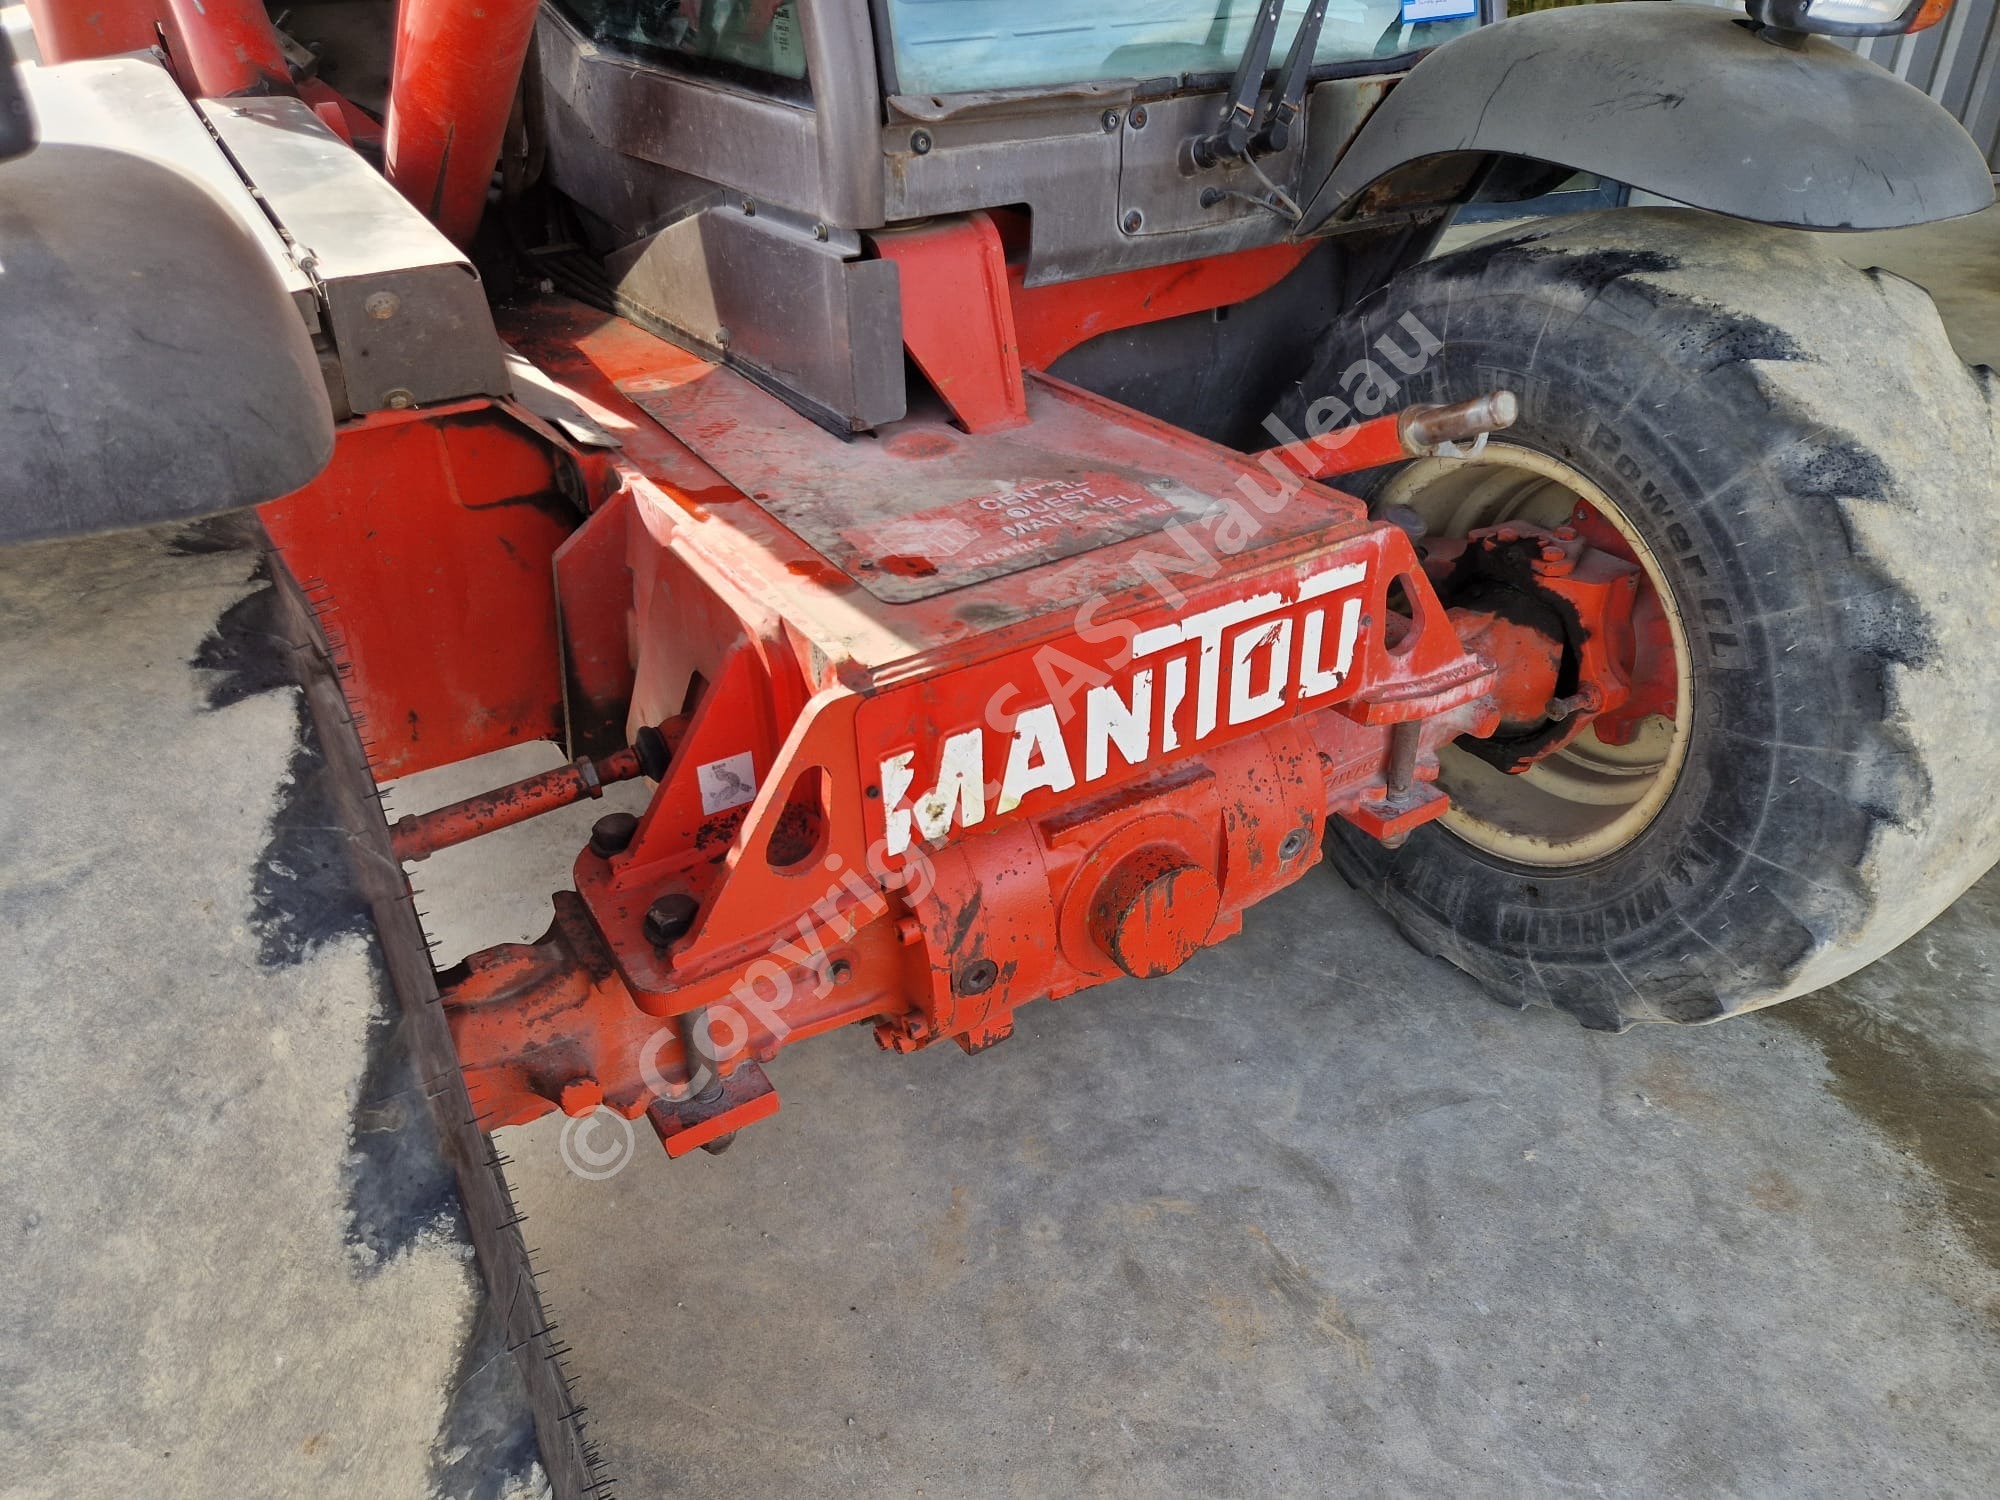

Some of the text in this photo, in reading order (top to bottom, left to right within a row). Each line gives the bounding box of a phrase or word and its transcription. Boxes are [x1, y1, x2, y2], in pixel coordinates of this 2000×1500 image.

[1006, 487, 1097, 519] OUEST
[1588, 422, 1708, 578] Power
[880, 561, 1367, 857] MANITOU
